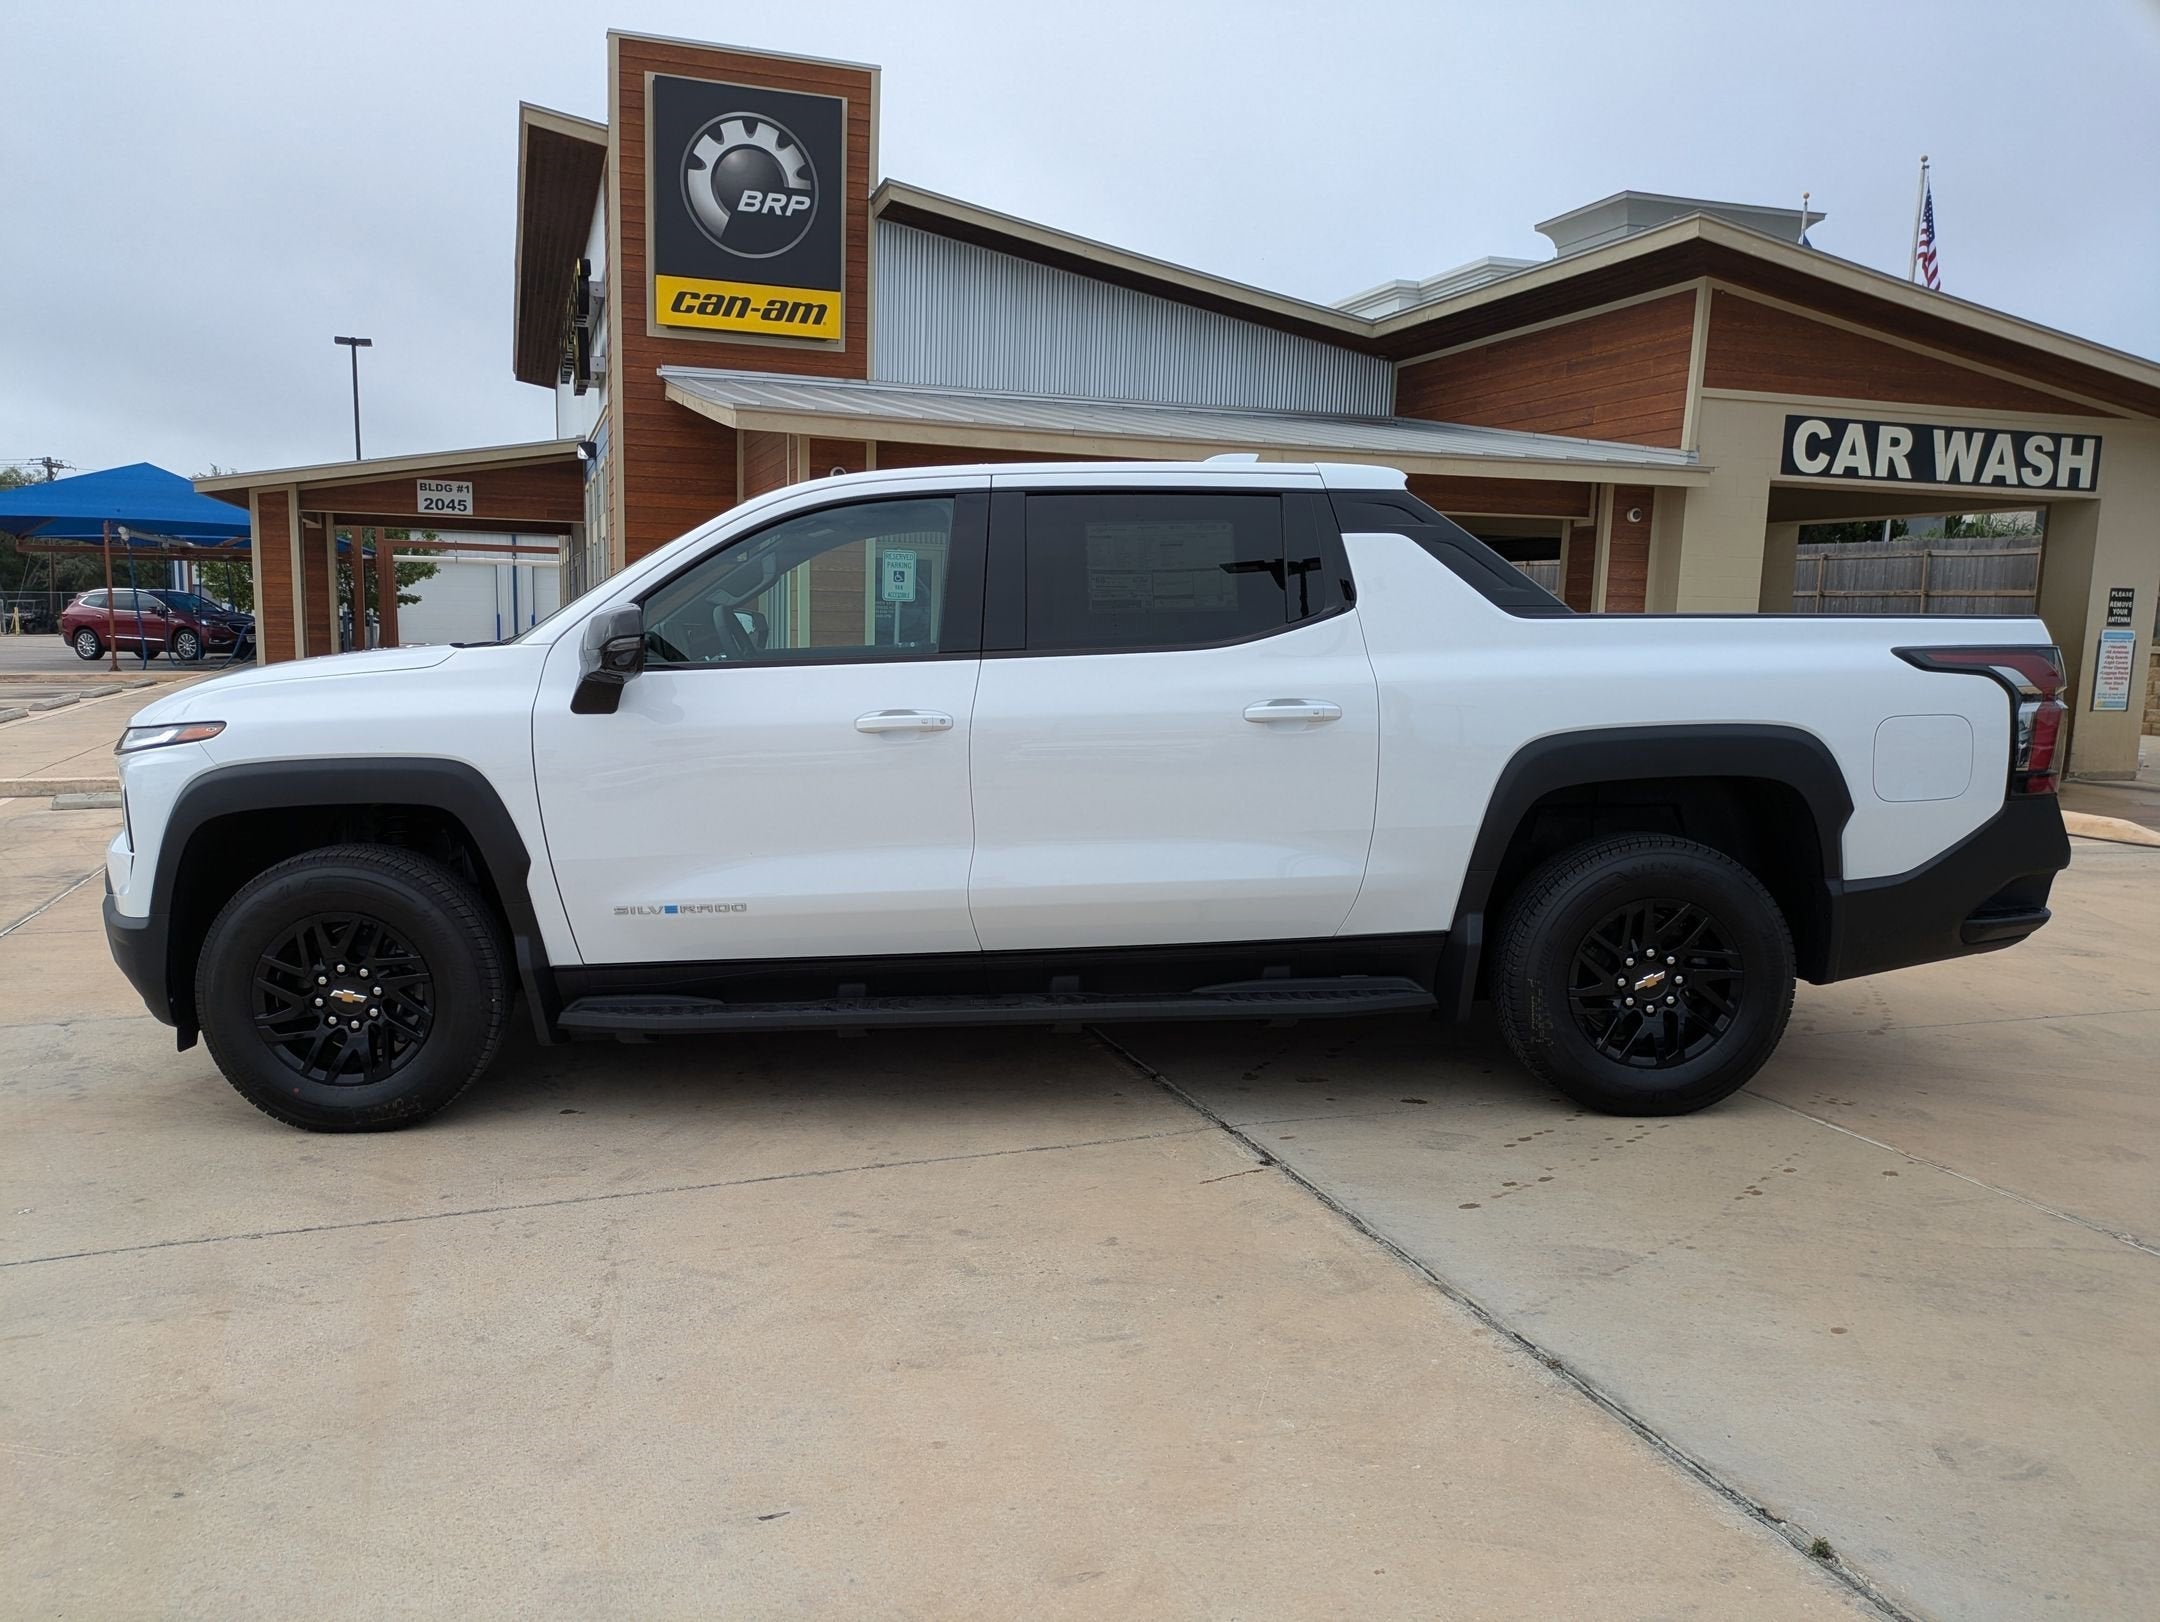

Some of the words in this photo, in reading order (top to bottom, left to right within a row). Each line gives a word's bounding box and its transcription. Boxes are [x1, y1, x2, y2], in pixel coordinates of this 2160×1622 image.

[736, 189, 811, 217] BRP
[670, 290, 828, 326] can-am
[1792, 419, 1914, 479] CAR
[1932, 429, 2097, 489] WASH
[419, 482, 453, 493] BLDG
[456, 484, 470, 494] #1
[423, 497, 467, 512] 2045
[885, 553, 914, 561] RESERVED
[886, 561, 912, 569] PARKING
[613, 902, 747, 915] SILVERADO
